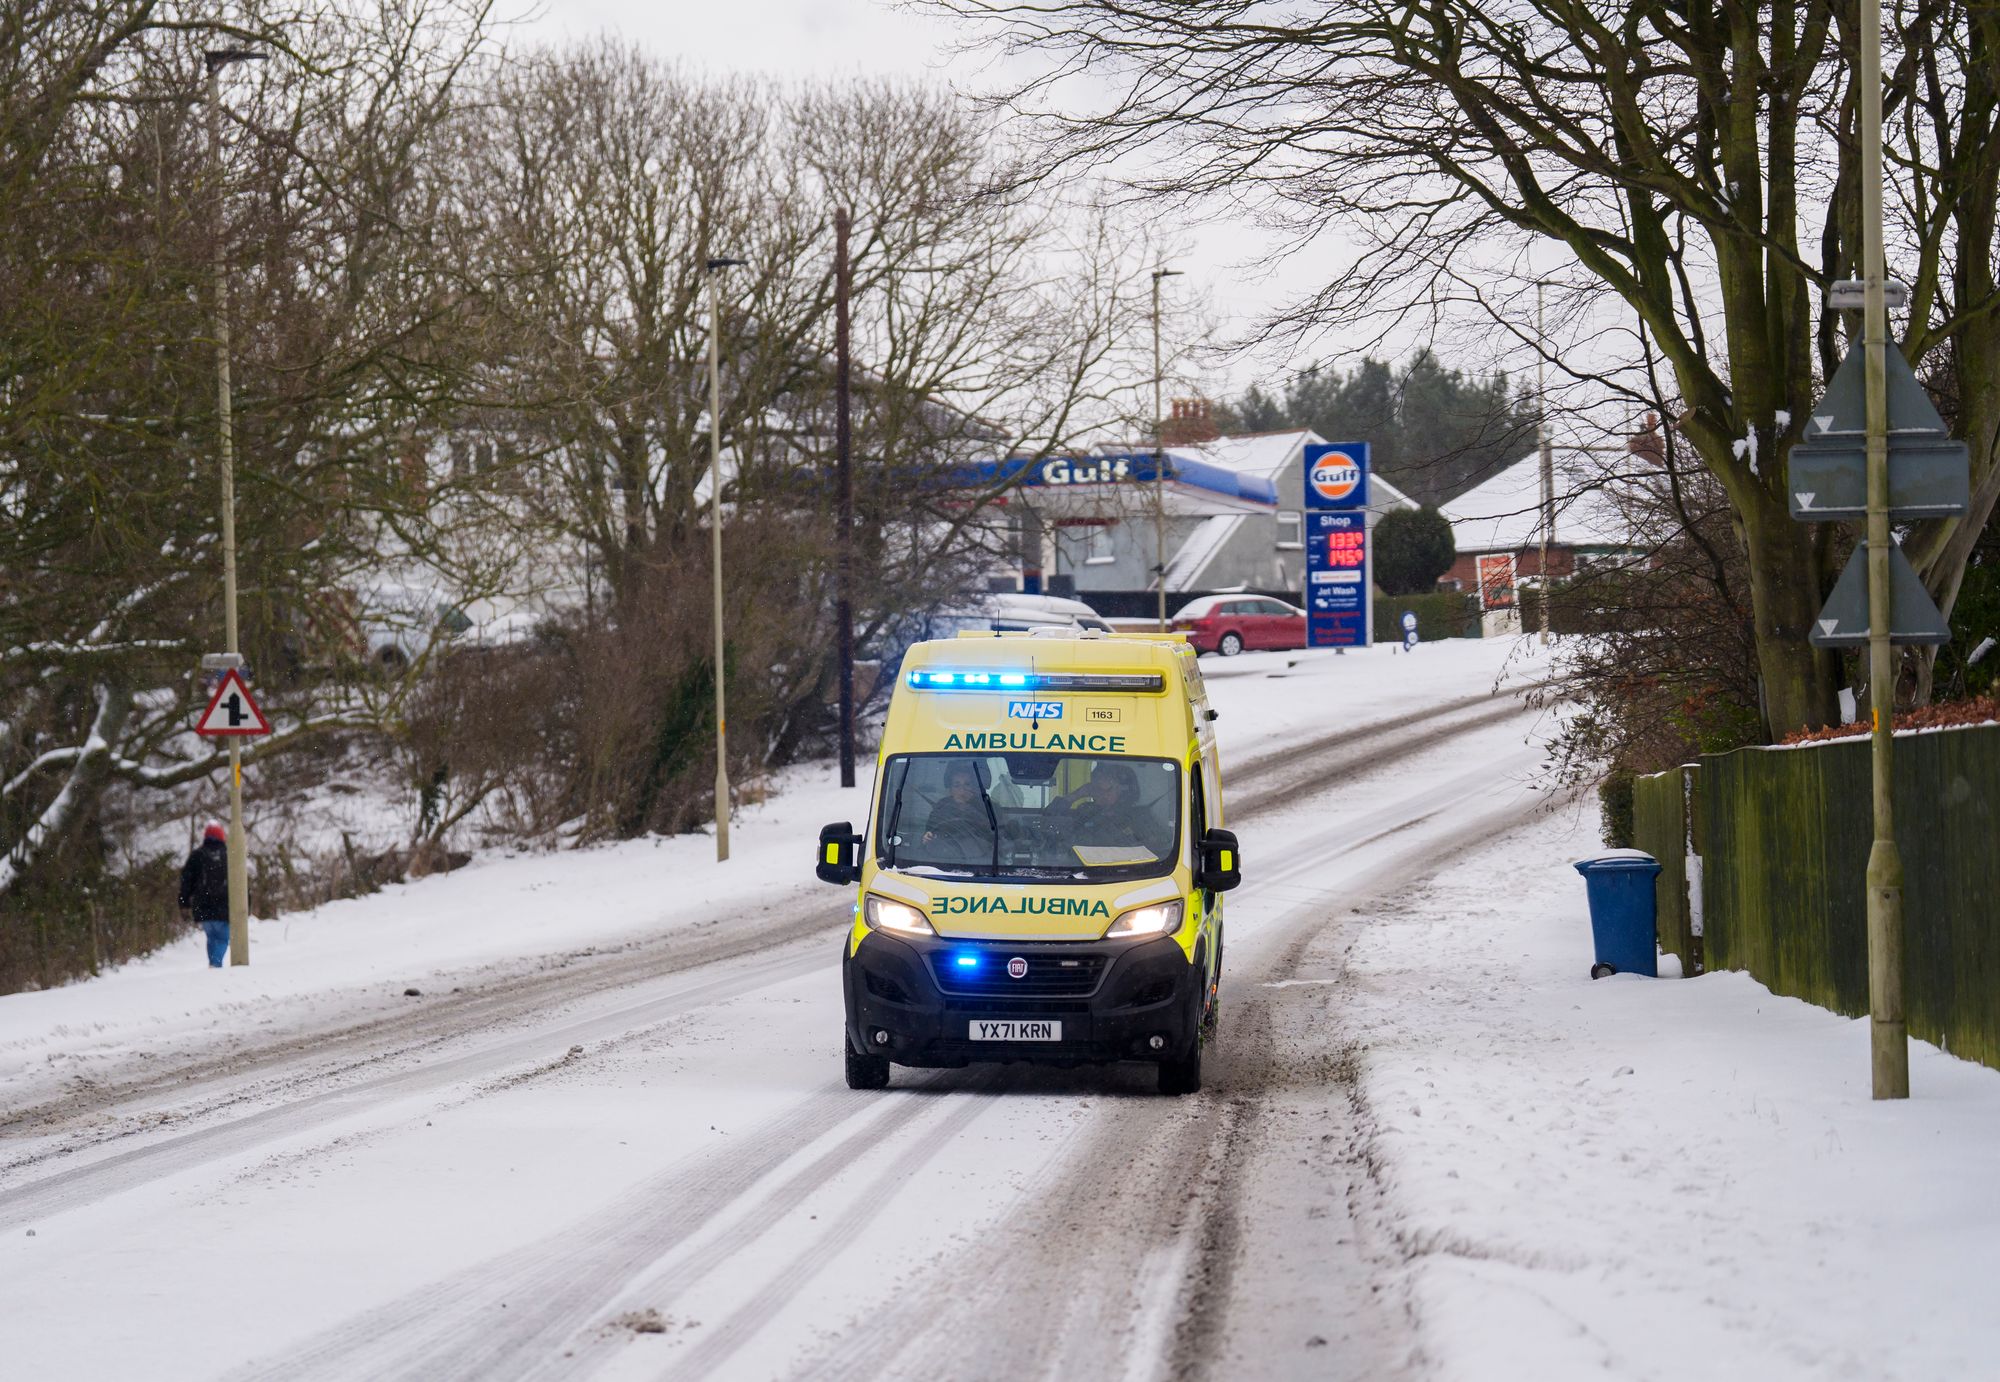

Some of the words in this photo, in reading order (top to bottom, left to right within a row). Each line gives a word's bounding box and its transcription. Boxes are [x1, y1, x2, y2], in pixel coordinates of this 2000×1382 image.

[1043, 459, 1129, 484] Gulf
[1314, 469, 1359, 482] Gulf
[1320, 515, 1351, 527] Shop
[1318, 586, 1331, 596] Jet
[1332, 586, 1357, 595] Wash
[1010, 702, 1062, 718] NHS
[1092, 711, 1113, 719] 1163
[943, 733, 1126, 752] AMBULANCE
[1012, 963, 1024, 973] FIAT
[979, 1023, 1015, 1038] YX71
[1020, 1023, 1051, 1038] KRN
